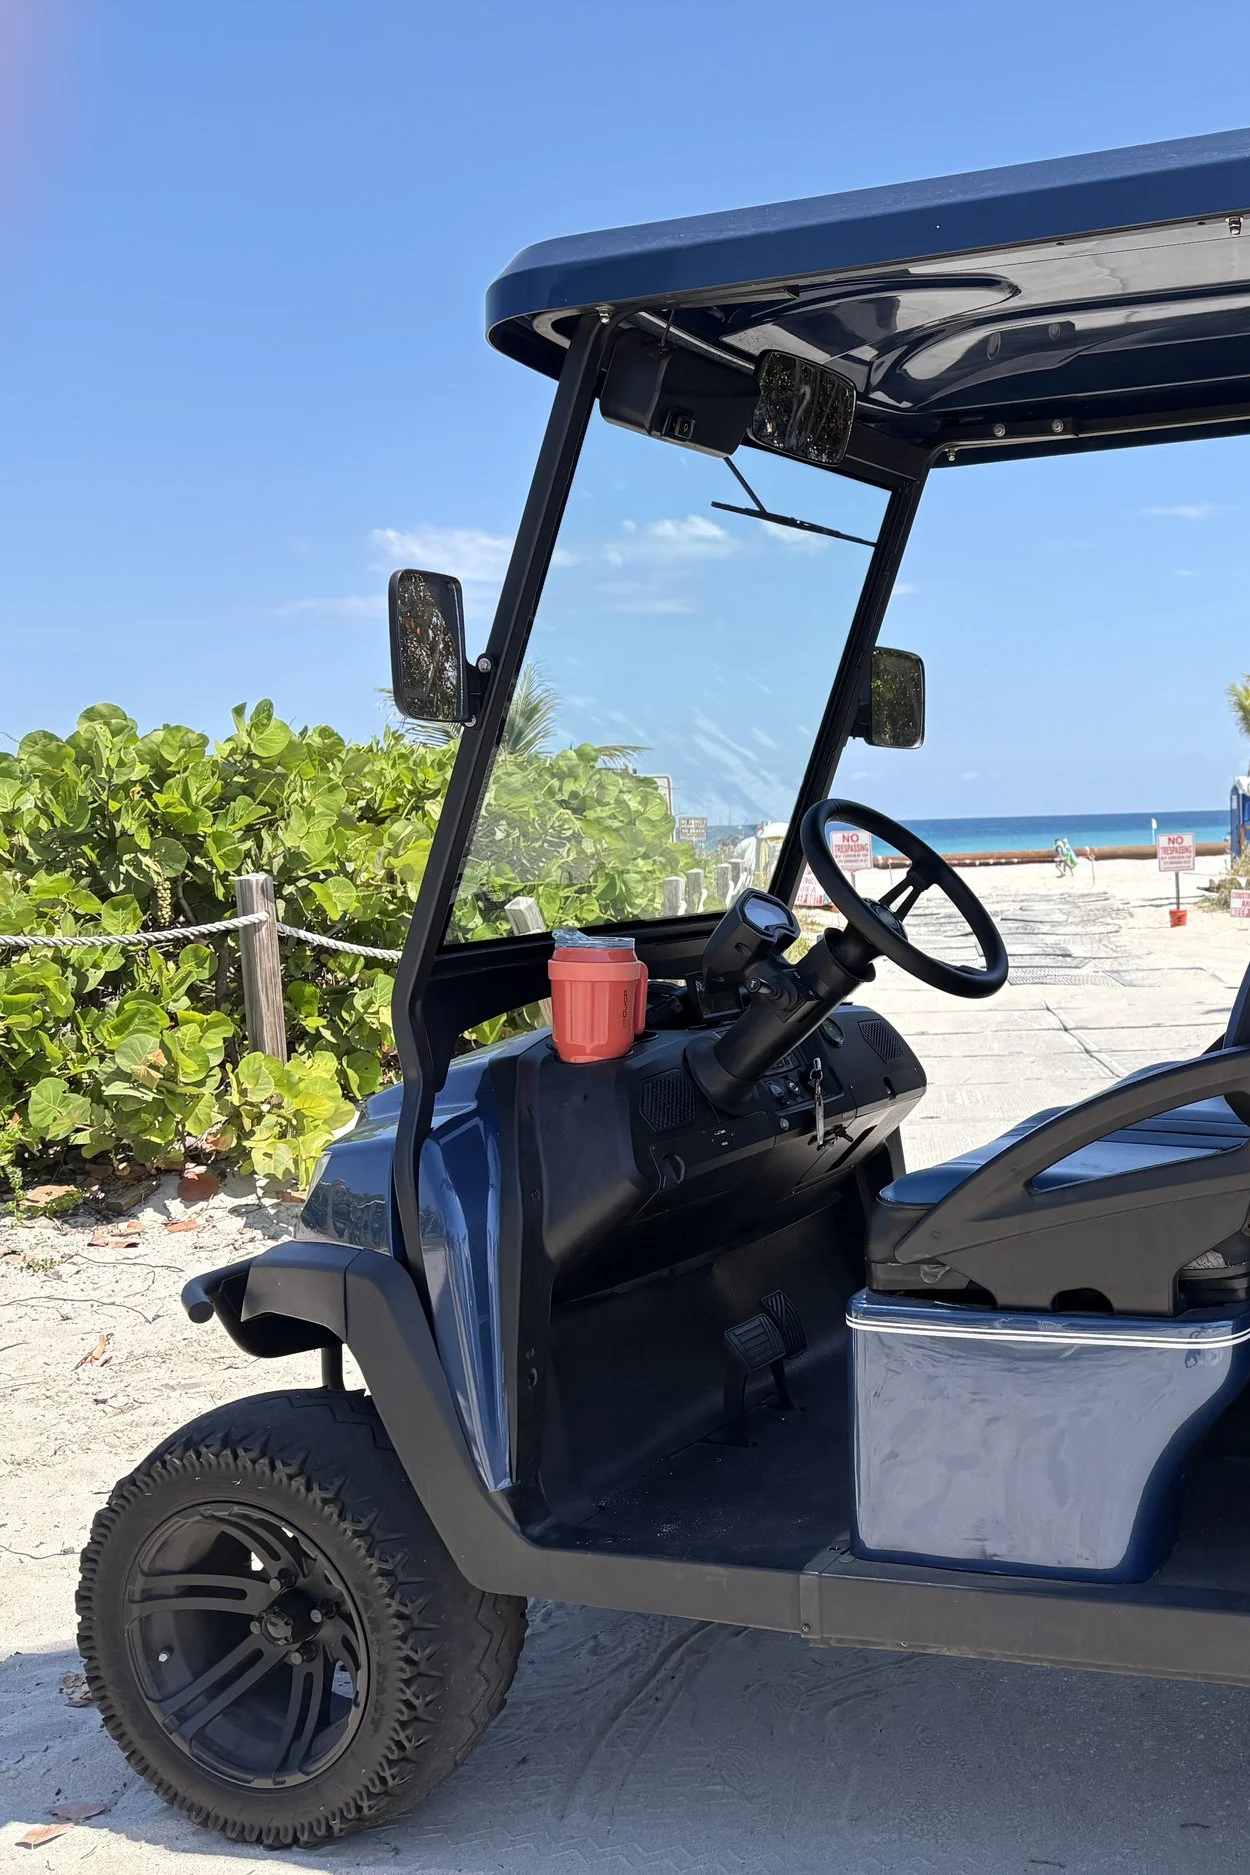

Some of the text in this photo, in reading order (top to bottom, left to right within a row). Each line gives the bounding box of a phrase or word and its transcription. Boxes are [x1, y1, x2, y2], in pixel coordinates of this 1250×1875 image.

[842, 833, 859, 843] NO
[1168, 836, 1184, 845] NO
[834, 843, 868, 854] TRESPASSING
[1160, 845, 1192, 855] TRESPASSING
[1232, 908, 1249, 917] KEEP
